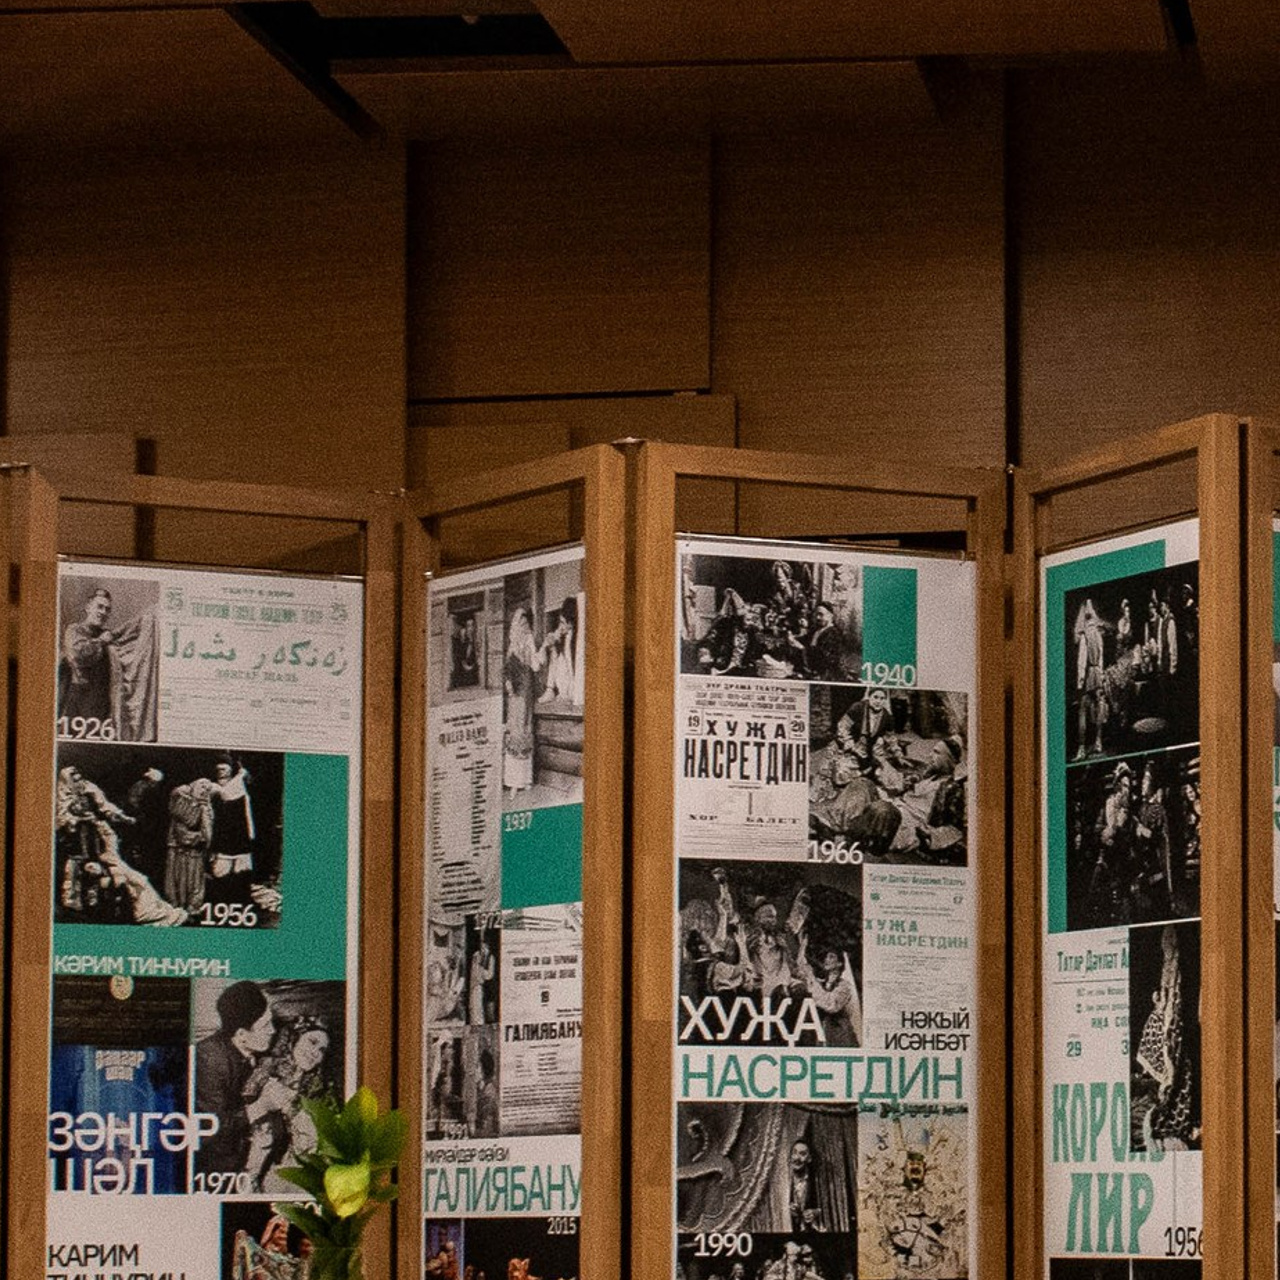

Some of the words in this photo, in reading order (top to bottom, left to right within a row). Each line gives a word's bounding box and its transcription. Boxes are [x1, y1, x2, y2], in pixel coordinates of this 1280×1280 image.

[862, 662, 917, 686] 1940
[57, 716, 116, 741] 1926
[684, 738, 807, 785] НАСРЕТДИН
[505, 812, 533, 832] 1937
[807, 840, 863, 864] 1966
[200, 902, 258, 927] 1956
[876, 935, 969, 950] НАСРЕТДИН
[54, 955, 123, 973] КӘРИМ
[128, 956, 230, 976] ТИНЧУРИН
[679, 995, 826, 1047] ХУҖА
[901, 1007, 970, 1029] НӘКЫЙ
[885, 1033, 970, 1051] ИСӘНБӘТ
[682, 1053, 963, 1112] НАСРЕТДИН
[49, 1111, 219, 1157] ЗӘҢГӘР
[1052, 1081, 1166, 1163] КОРО
[193, 1172, 250, 1195] 1970
[424, 1164, 582, 1212] ГАЛИЯБАНУ
[1065, 1172, 1154, 1255] ЛИР
[547, 1217, 577, 1235] 2015
[48, 1244, 139, 1268] КАРИМ
[694, 1232, 753, 1258] 1990
